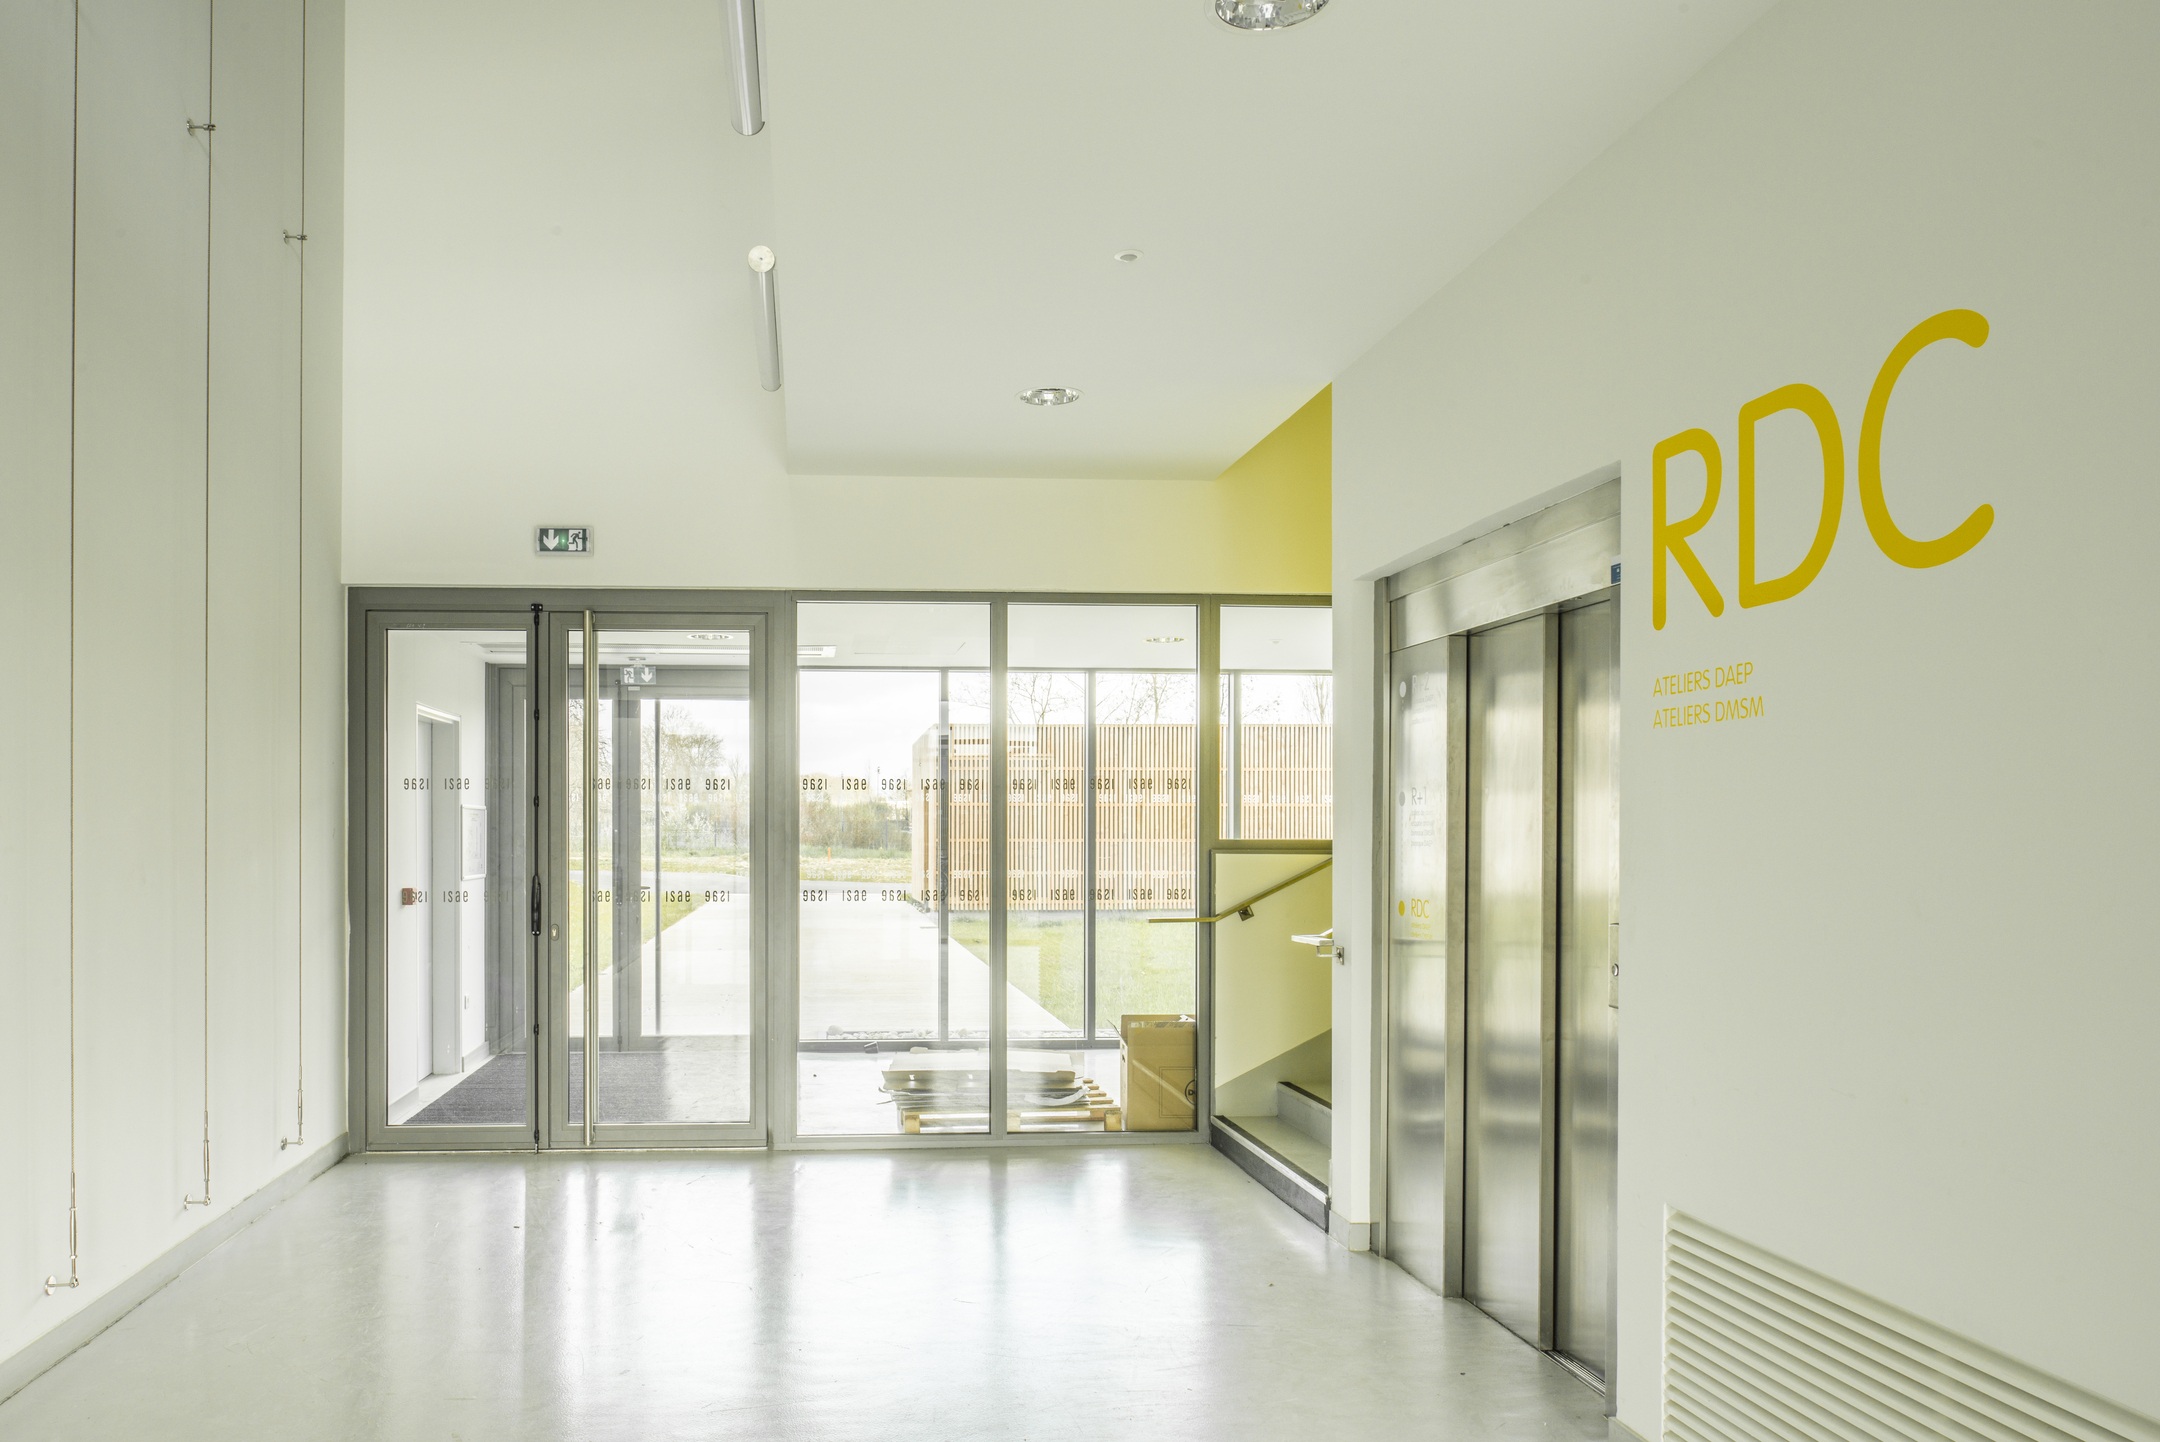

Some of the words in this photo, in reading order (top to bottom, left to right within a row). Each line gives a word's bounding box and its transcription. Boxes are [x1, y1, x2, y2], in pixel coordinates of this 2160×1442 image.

[1652, 308, 1995, 631] RDC
[1653, 669, 1711, 697] ATELIERS
[1715, 661, 1754, 688] DAEP
[1653, 702, 1711, 729] ATELIERS
[1715, 695, 1765, 722] DMSM
[1411, 786, 1427, 806] R+1
[1411, 898, 1430, 919] RDC
